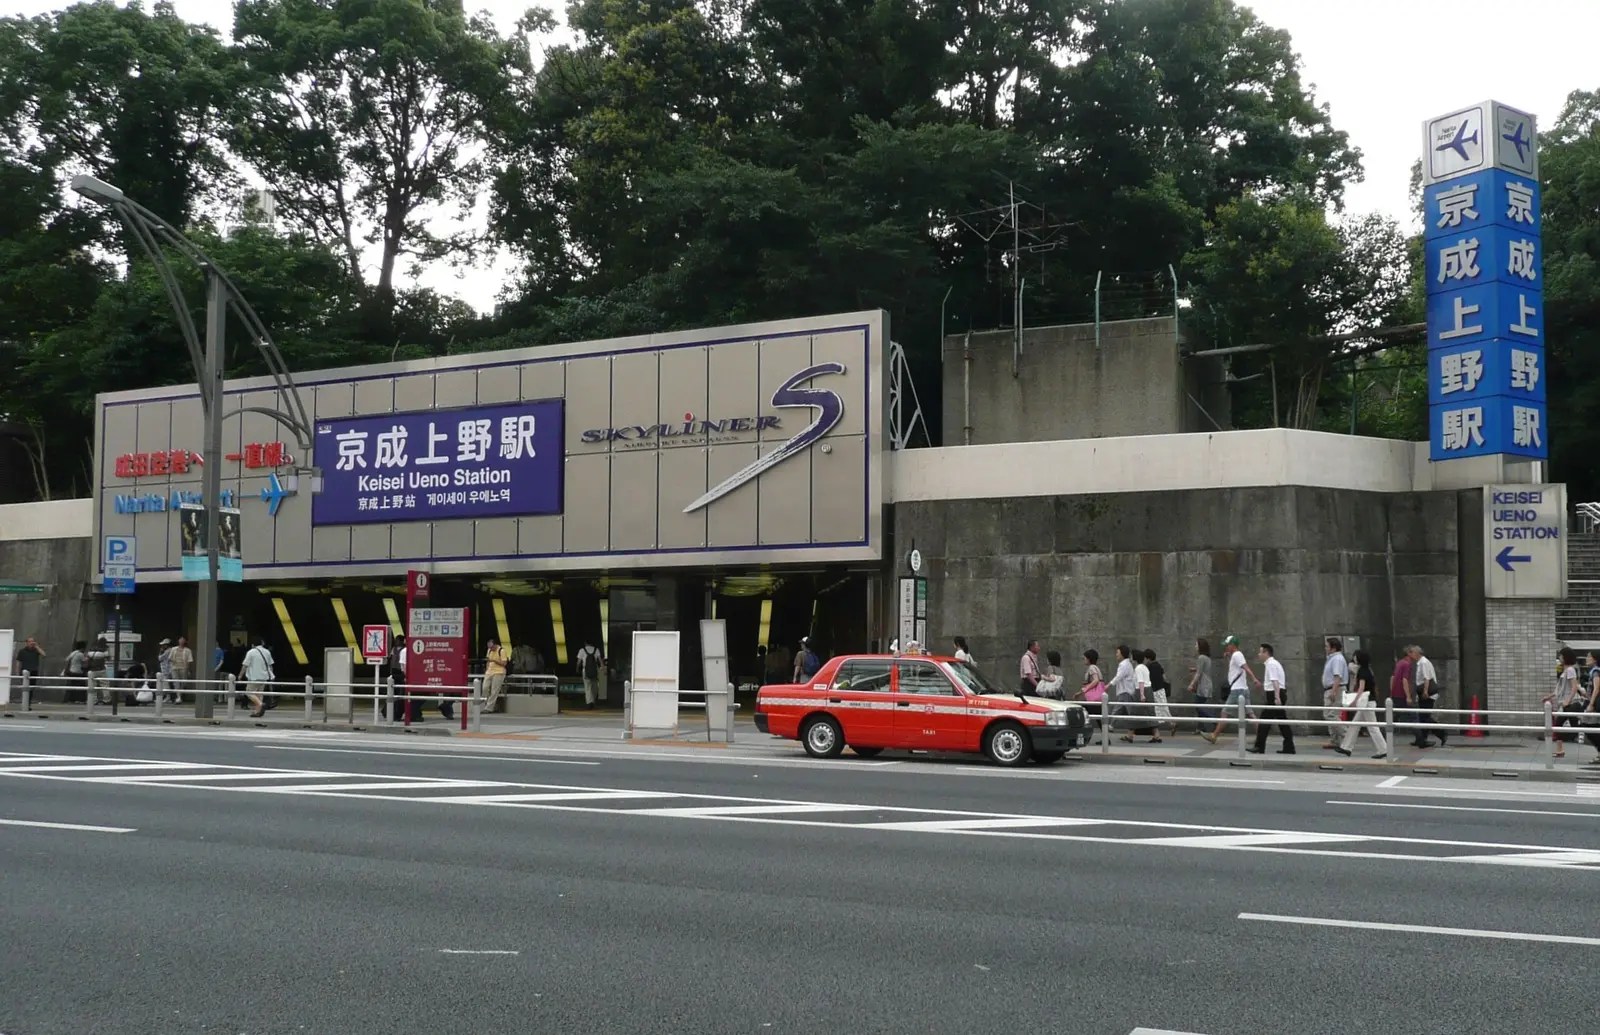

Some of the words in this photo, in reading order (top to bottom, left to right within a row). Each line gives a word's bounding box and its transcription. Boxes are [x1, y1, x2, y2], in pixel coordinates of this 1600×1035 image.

[1435, 184, 1484, 450] 京成上野駅
[1505, 181, 1542, 449] 京成上野駅
[335, 414, 537, 471] 京成上野駅
[358, 473, 405, 492] Keisei
[409, 472, 450, 490] Ueno
[454, 467, 511, 486] Station
[114, 491, 166, 514] Narita
[357, 494, 416, 511] 京成上野站
[426, 491, 466, 507] 게이세이
[469, 488, 511, 504] 우에노역
[1493, 491, 1543, 504] KEISEI
[1493, 510, 1537, 522] UENO
[1493, 527, 1559, 539] STATION
[109, 540, 128, 561] P
